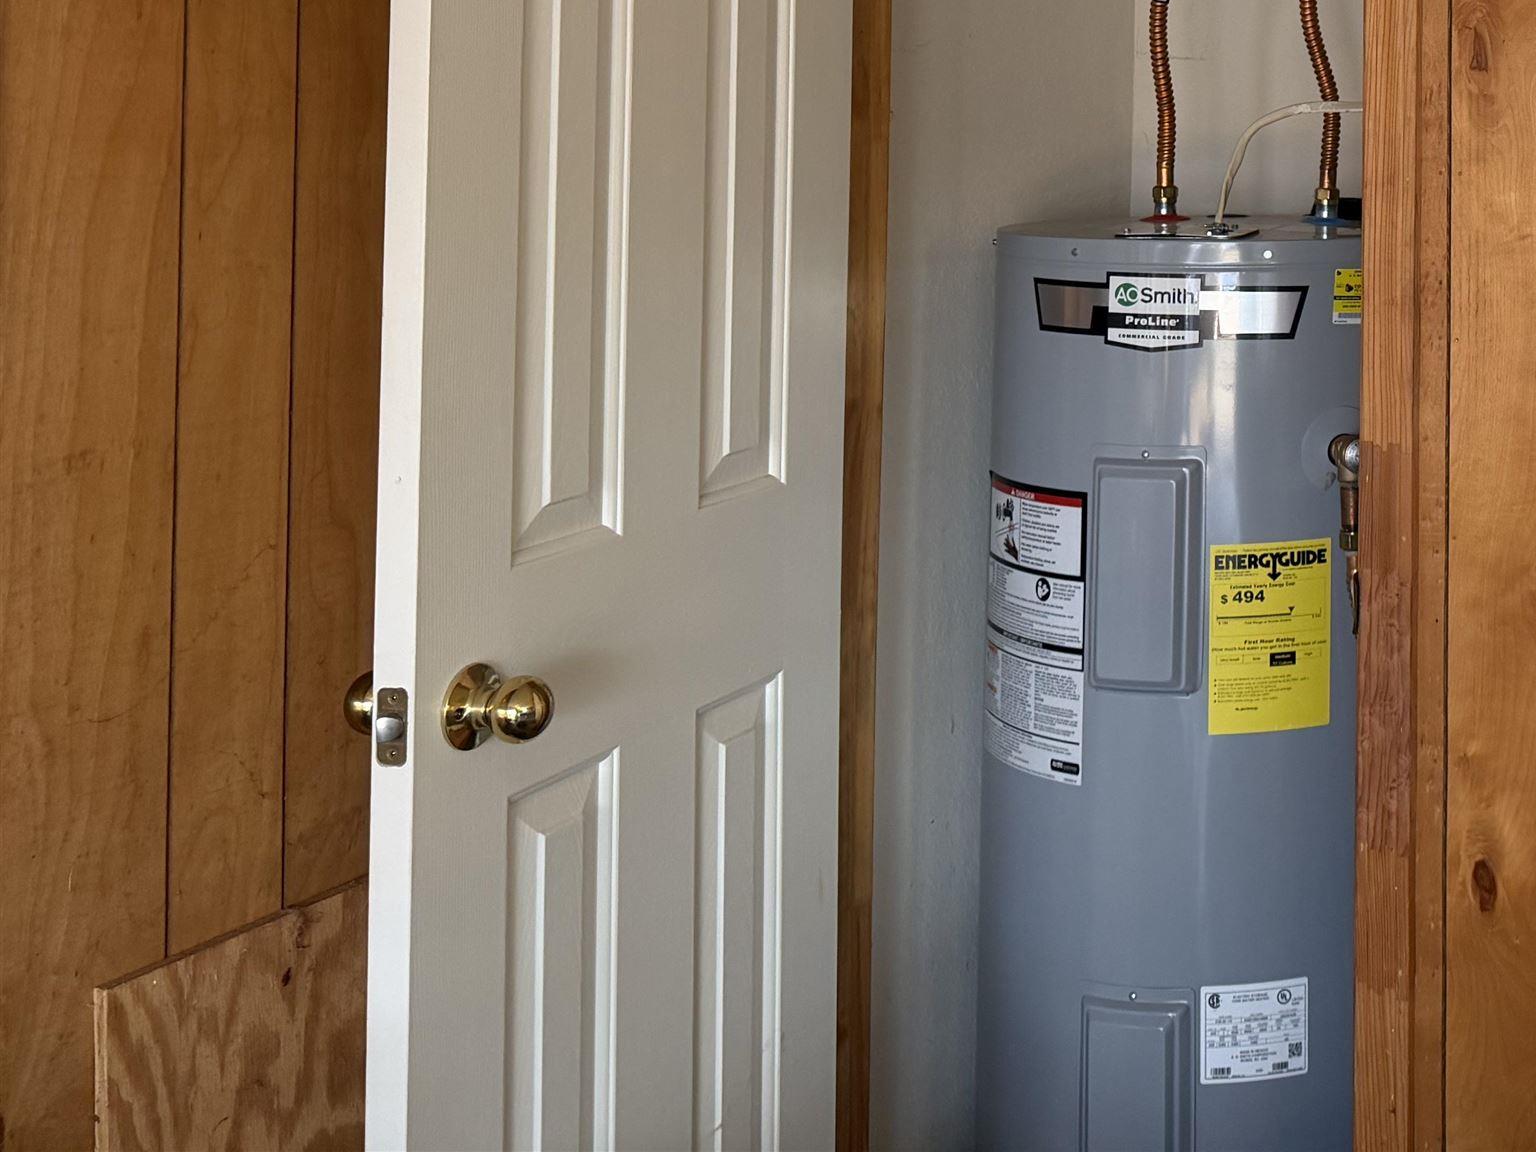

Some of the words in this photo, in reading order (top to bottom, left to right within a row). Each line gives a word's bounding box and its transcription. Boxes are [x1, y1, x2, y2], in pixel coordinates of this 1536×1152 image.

[1141, 287, 1195, 304] Smith
[1125, 315, 1179, 326] ProLine
[1220, 594, 1228, 605] $
[1232, 589, 1266, 604] 494
